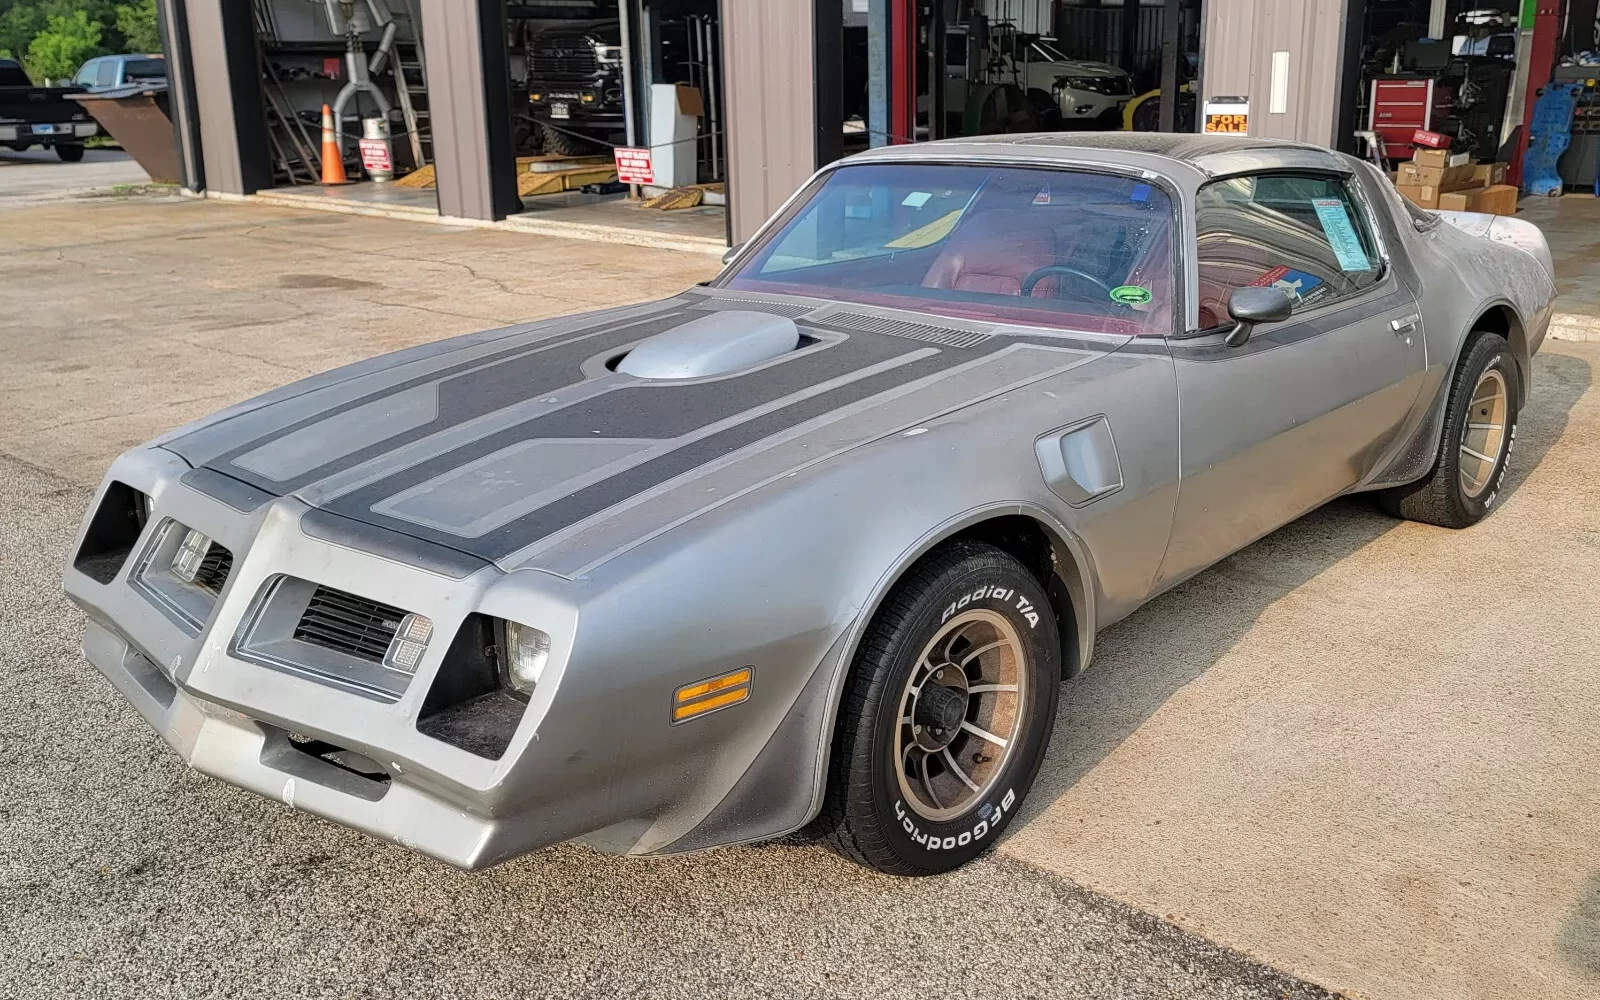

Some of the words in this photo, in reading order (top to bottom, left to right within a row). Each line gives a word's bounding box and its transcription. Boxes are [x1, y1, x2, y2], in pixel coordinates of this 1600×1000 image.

[1205, 122, 1248, 132] SALE
[1211, 114, 1246, 124] FOR
[941, 585, 1014, 625] Radial
[1015, 595, 1040, 629] T/A
[895, 788, 1016, 851] BFGoodrich
